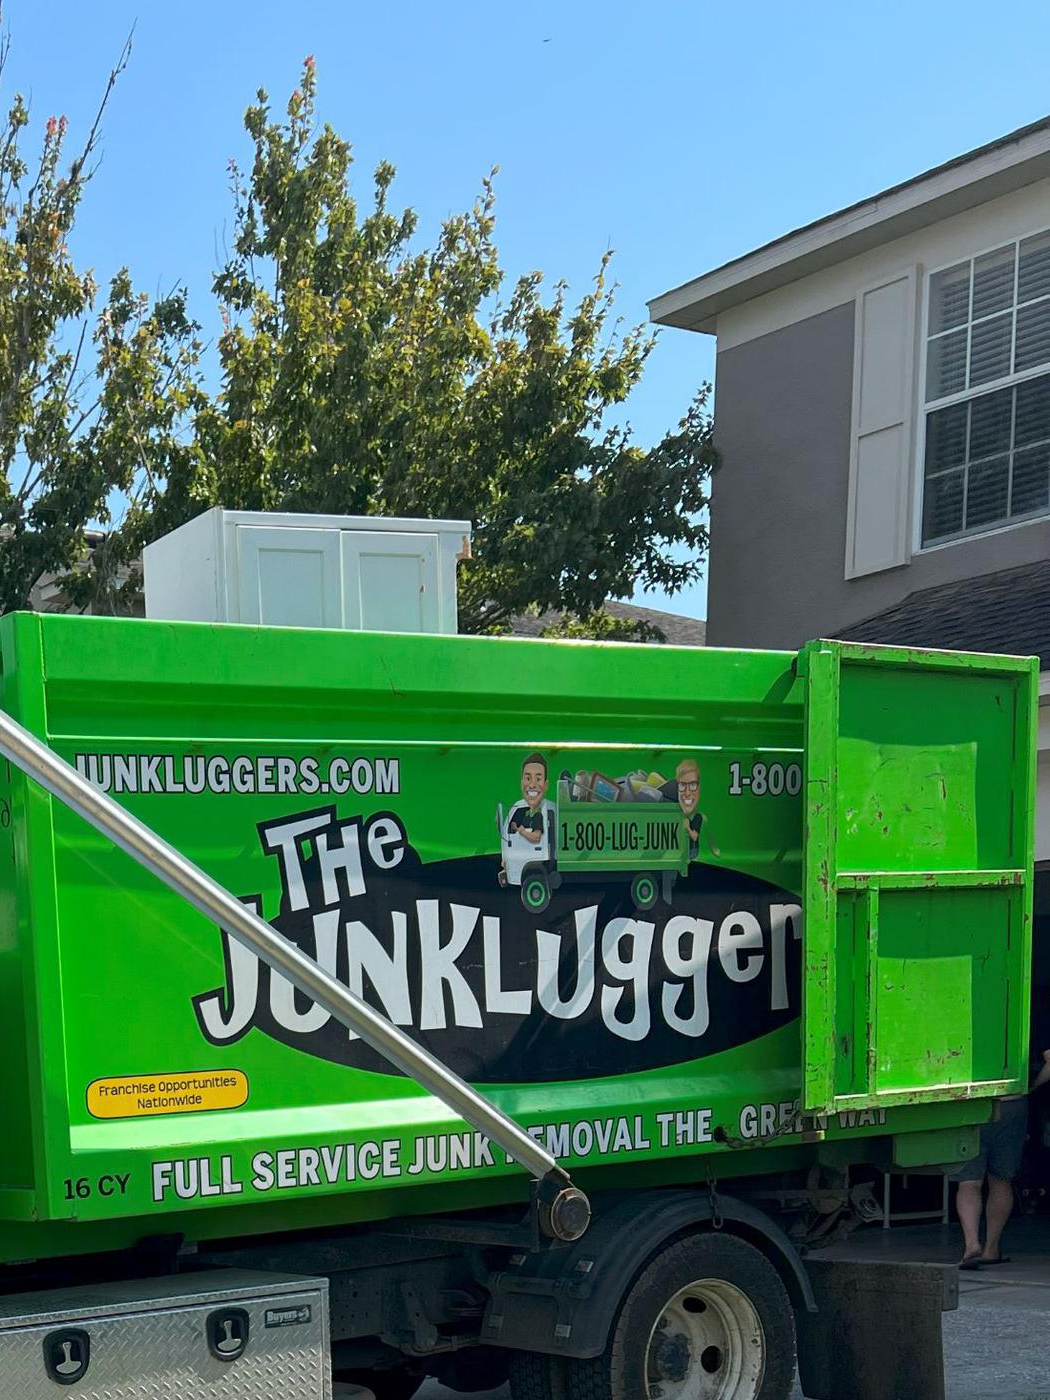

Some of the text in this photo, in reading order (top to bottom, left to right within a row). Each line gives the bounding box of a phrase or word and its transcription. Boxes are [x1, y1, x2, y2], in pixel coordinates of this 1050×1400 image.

[561, 821, 680, 852] 1-800-LUG-JUNK
[99, 1076, 237, 1096] Franchise Opportunities
[137, 1094, 202, 1109] Nationwide
[152, 1156, 243, 1202] FULL
[252, 1140, 401, 1191] SERVICE
[407, 1130, 496, 1174] JUNK
[506, 1115, 650, 1165] MOVAL
[656, 1108, 713, 1146] THE
[63, 1173, 131, 1200] 16 CY
